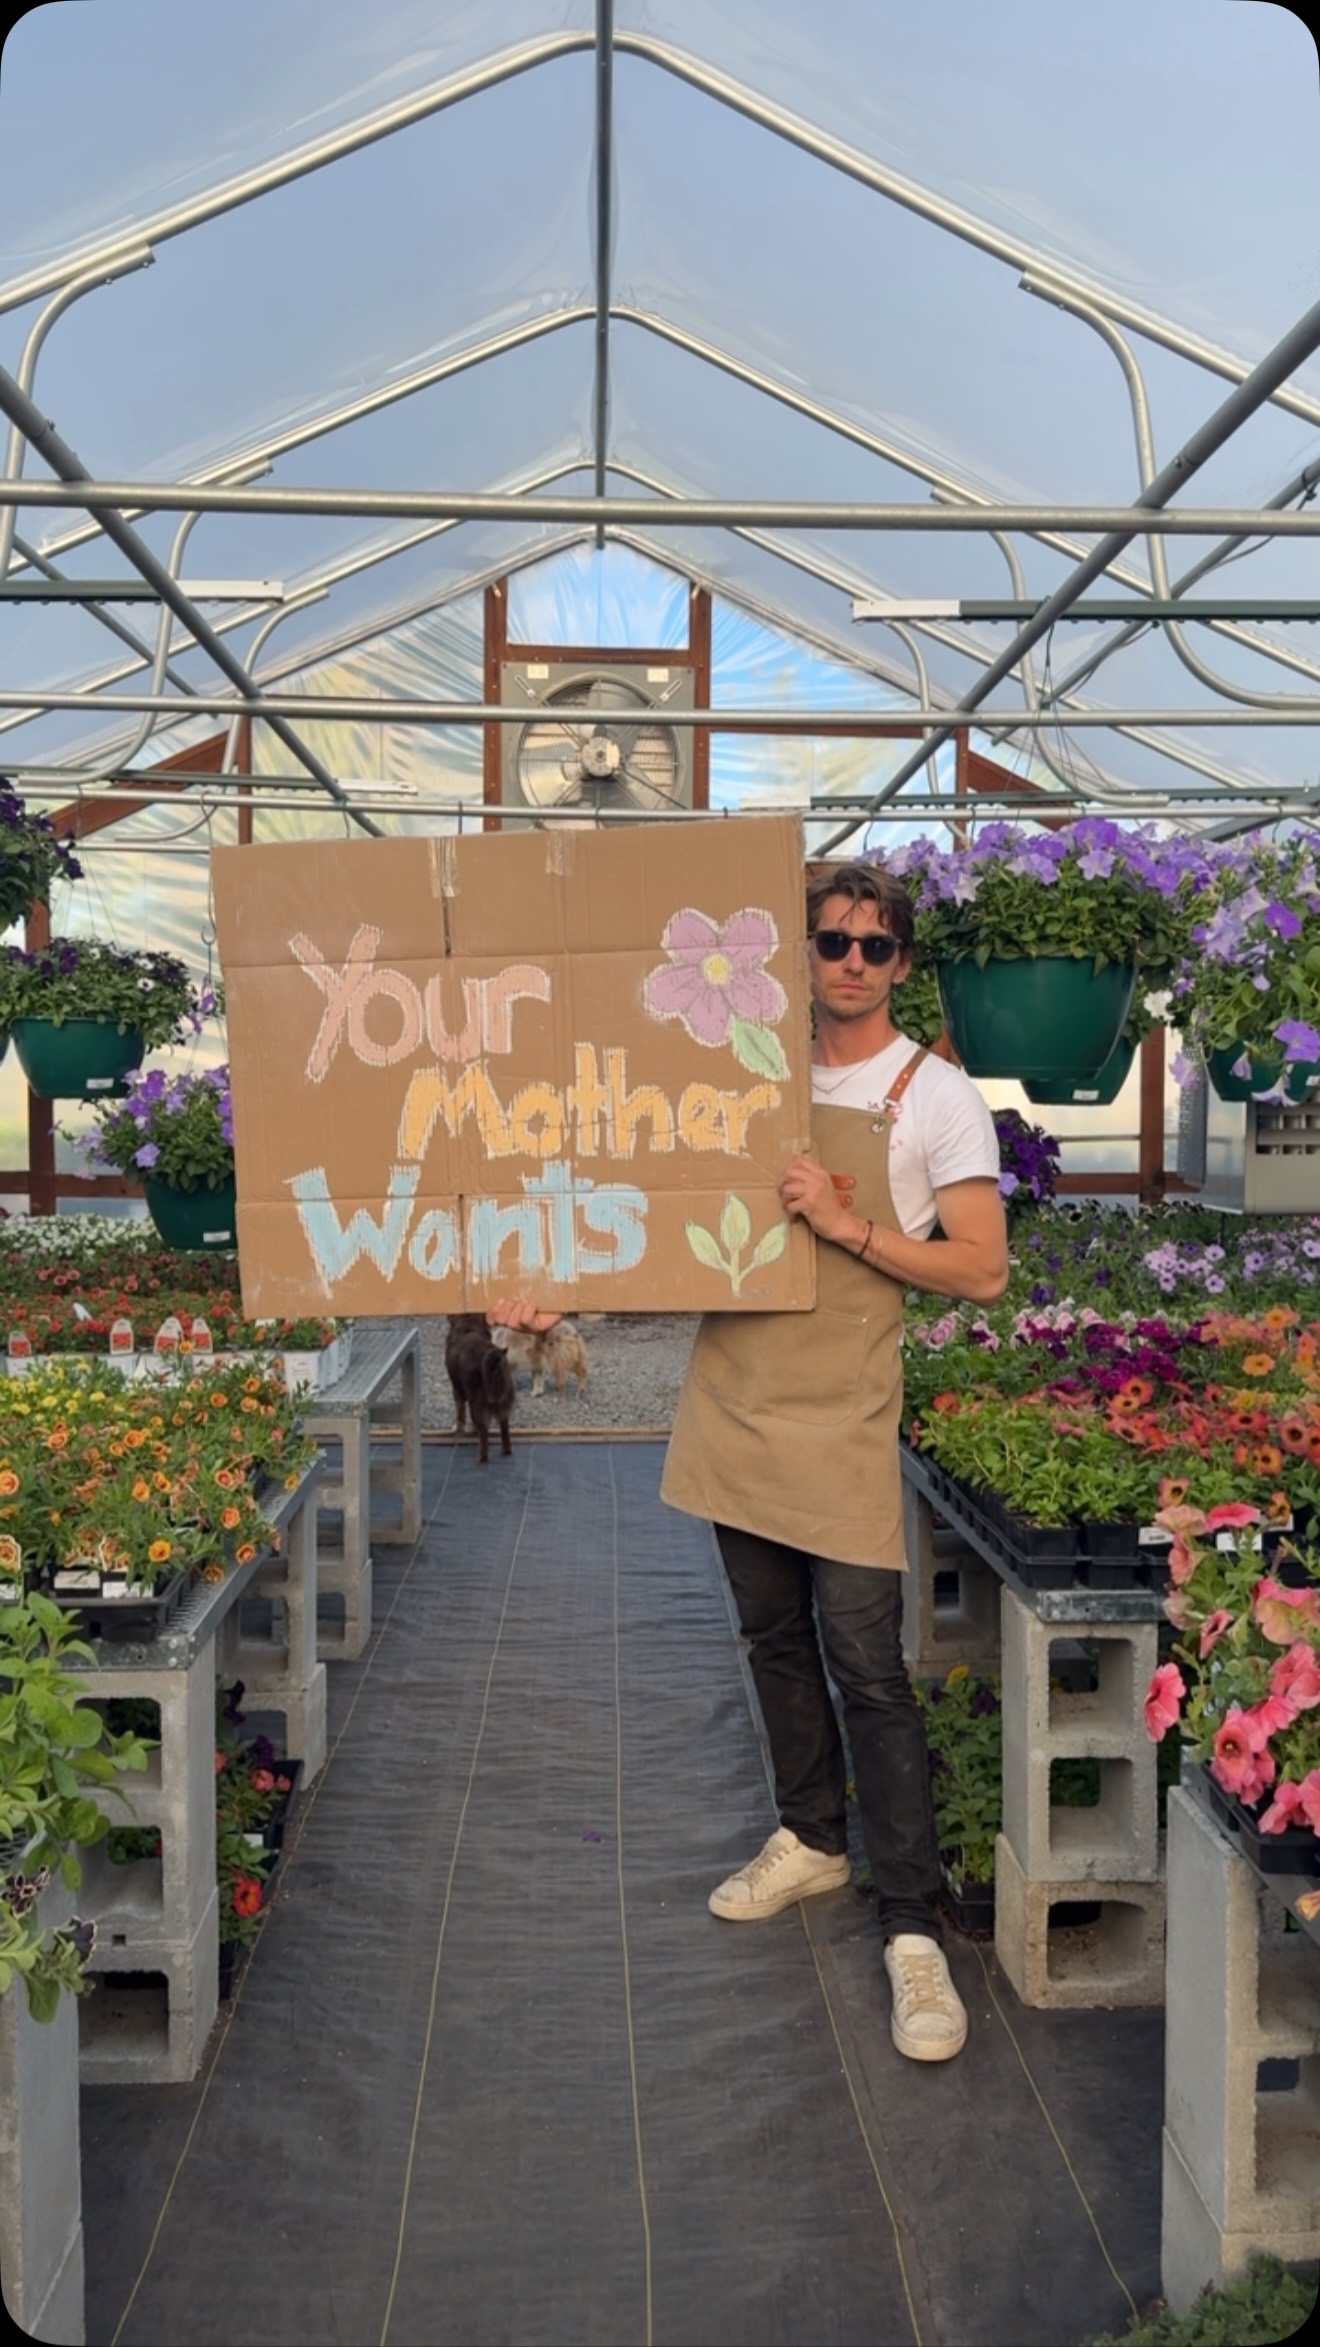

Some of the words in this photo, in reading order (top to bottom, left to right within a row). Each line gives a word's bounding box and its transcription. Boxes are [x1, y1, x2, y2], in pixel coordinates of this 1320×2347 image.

[288, 923, 551, 1083] Your
[397, 1042, 782, 1160] Mother
[283, 1160, 648, 1298] Wants
